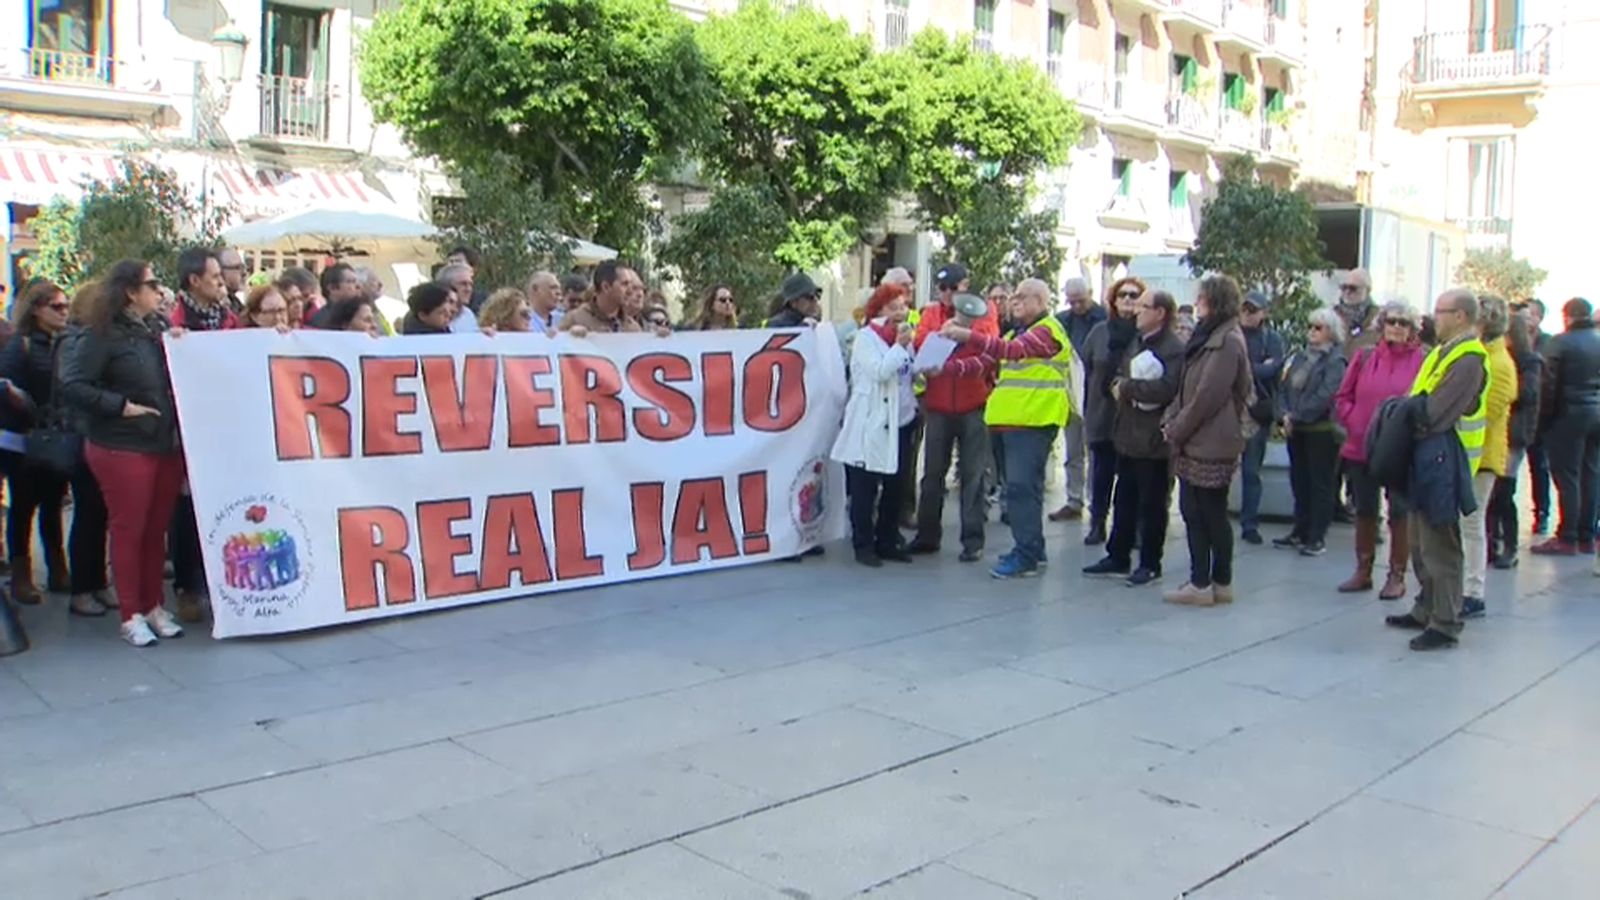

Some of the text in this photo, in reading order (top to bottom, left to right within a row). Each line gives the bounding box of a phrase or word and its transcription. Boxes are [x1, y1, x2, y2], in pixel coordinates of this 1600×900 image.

[268, 333, 807, 461] REVERSIÓ
[338, 487, 604, 612] REAL
[627, 470, 771, 570] JA!
